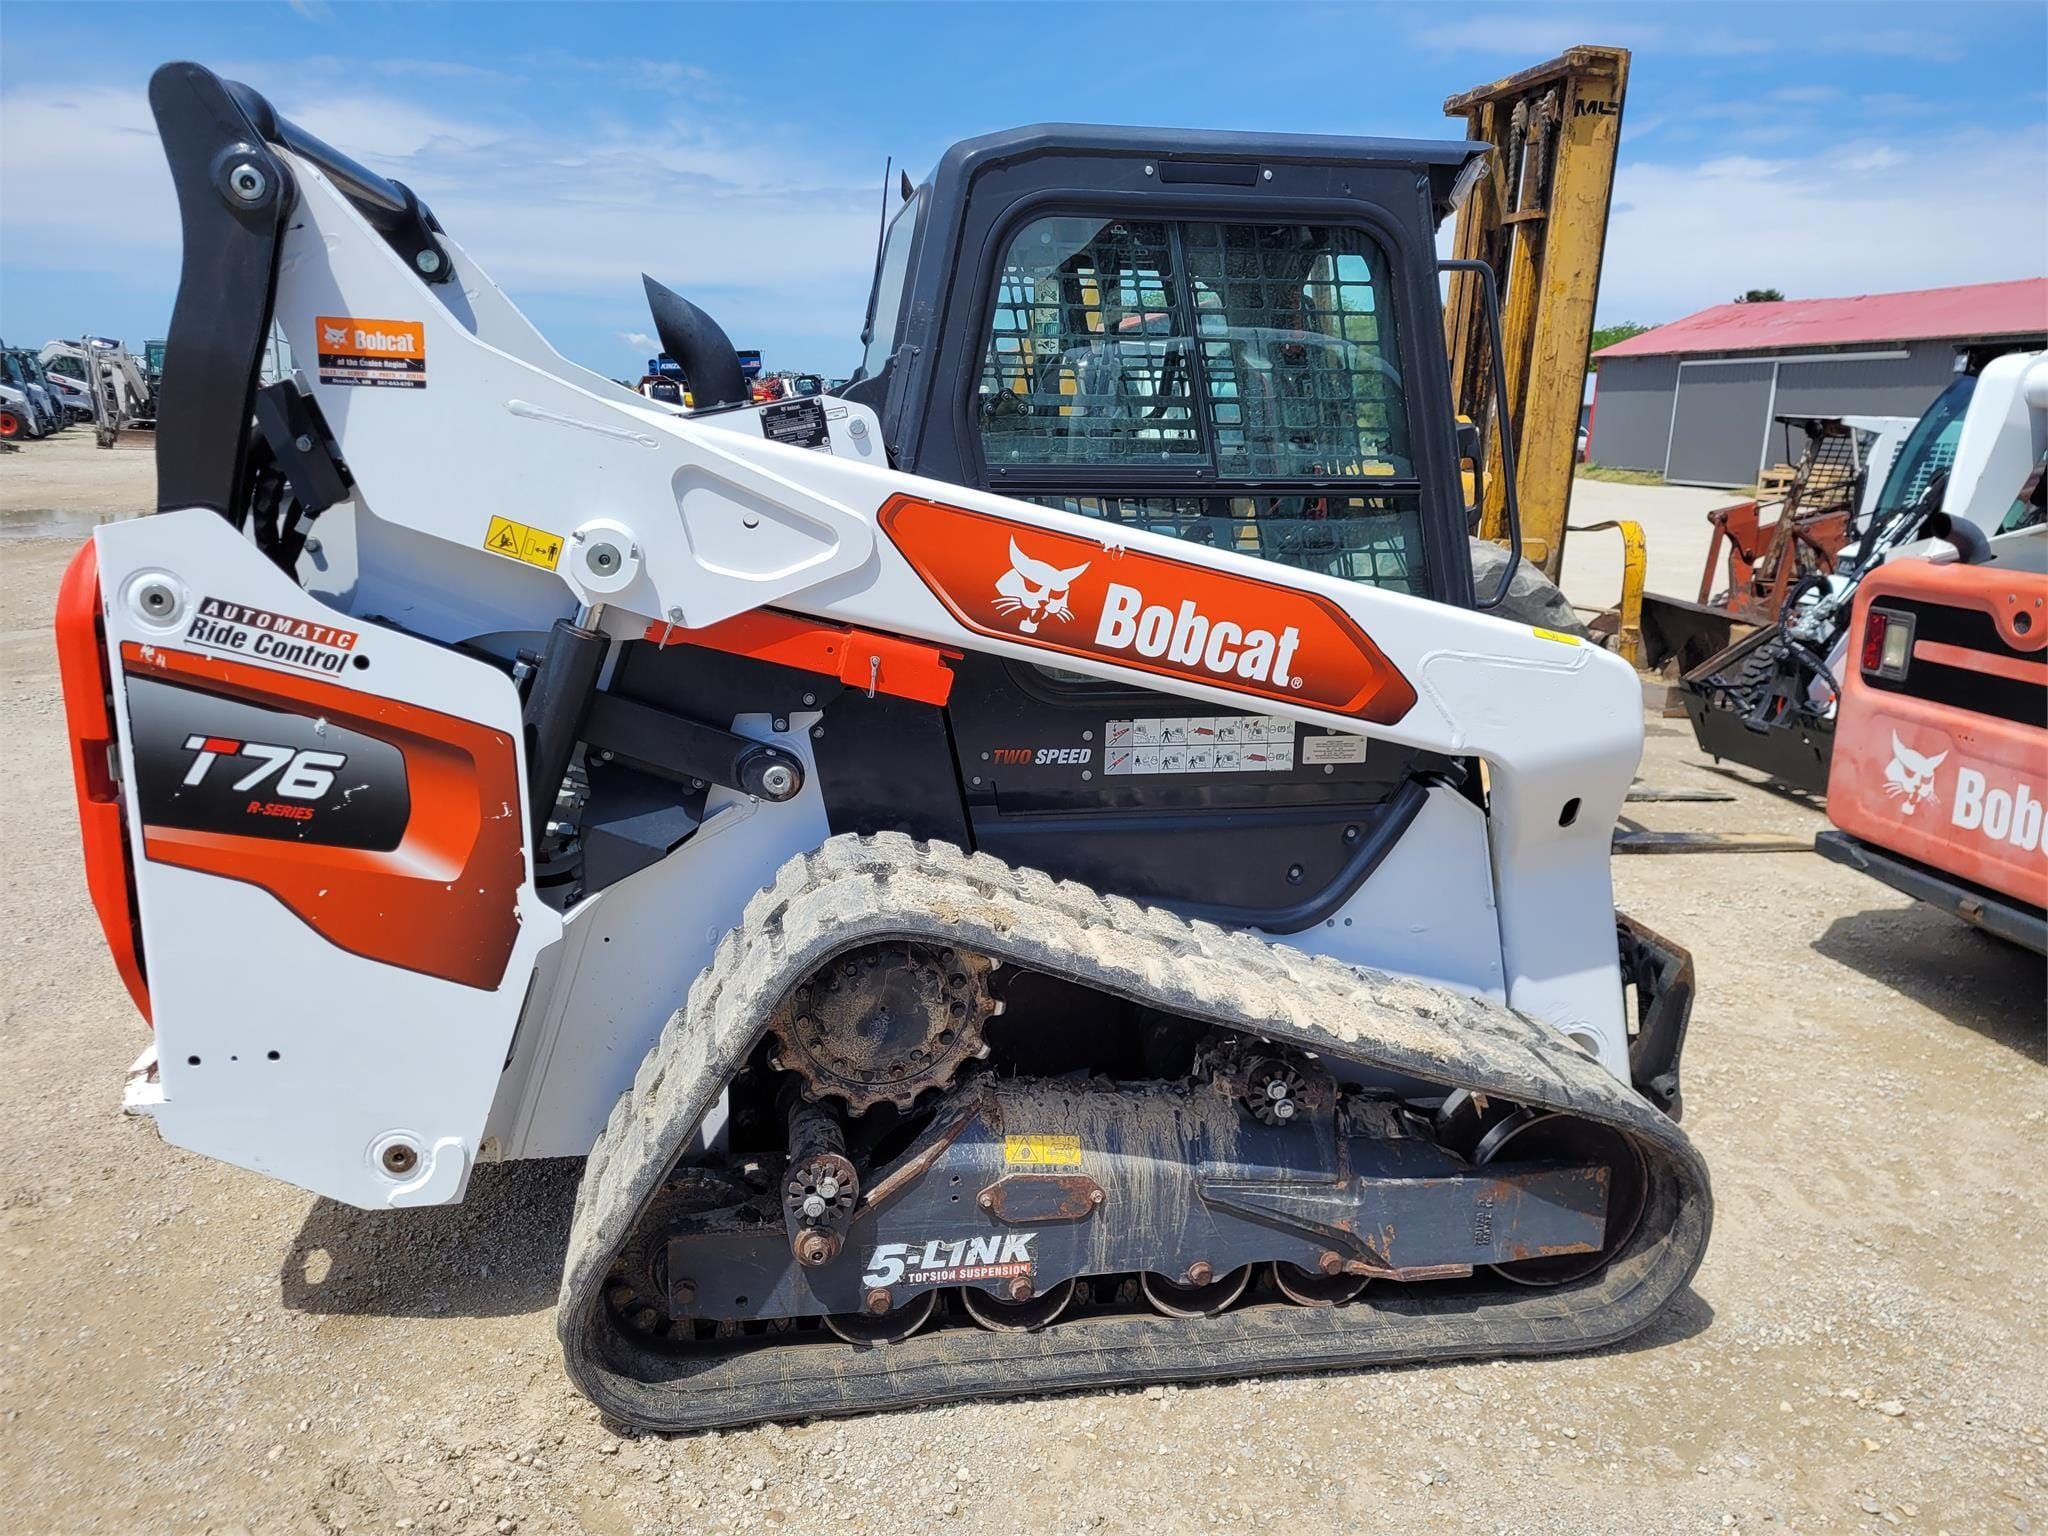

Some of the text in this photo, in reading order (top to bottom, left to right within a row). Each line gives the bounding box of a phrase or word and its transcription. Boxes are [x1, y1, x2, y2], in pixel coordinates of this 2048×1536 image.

[355, 330, 415, 352] Bobcat
[187, 616, 349, 673] Ride Control
[204, 601, 352, 648] AUTOMATIC
[1095, 582, 1300, 687] Bobcat
[181, 734, 348, 801] T76
[993, 748, 1092, 765] TWO SPEED
[246, 801, 316, 821] R-SERIES
[862, 1232, 1039, 1289] 5-LINK
[959, 1264, 1029, 1280] SUSPENSION
